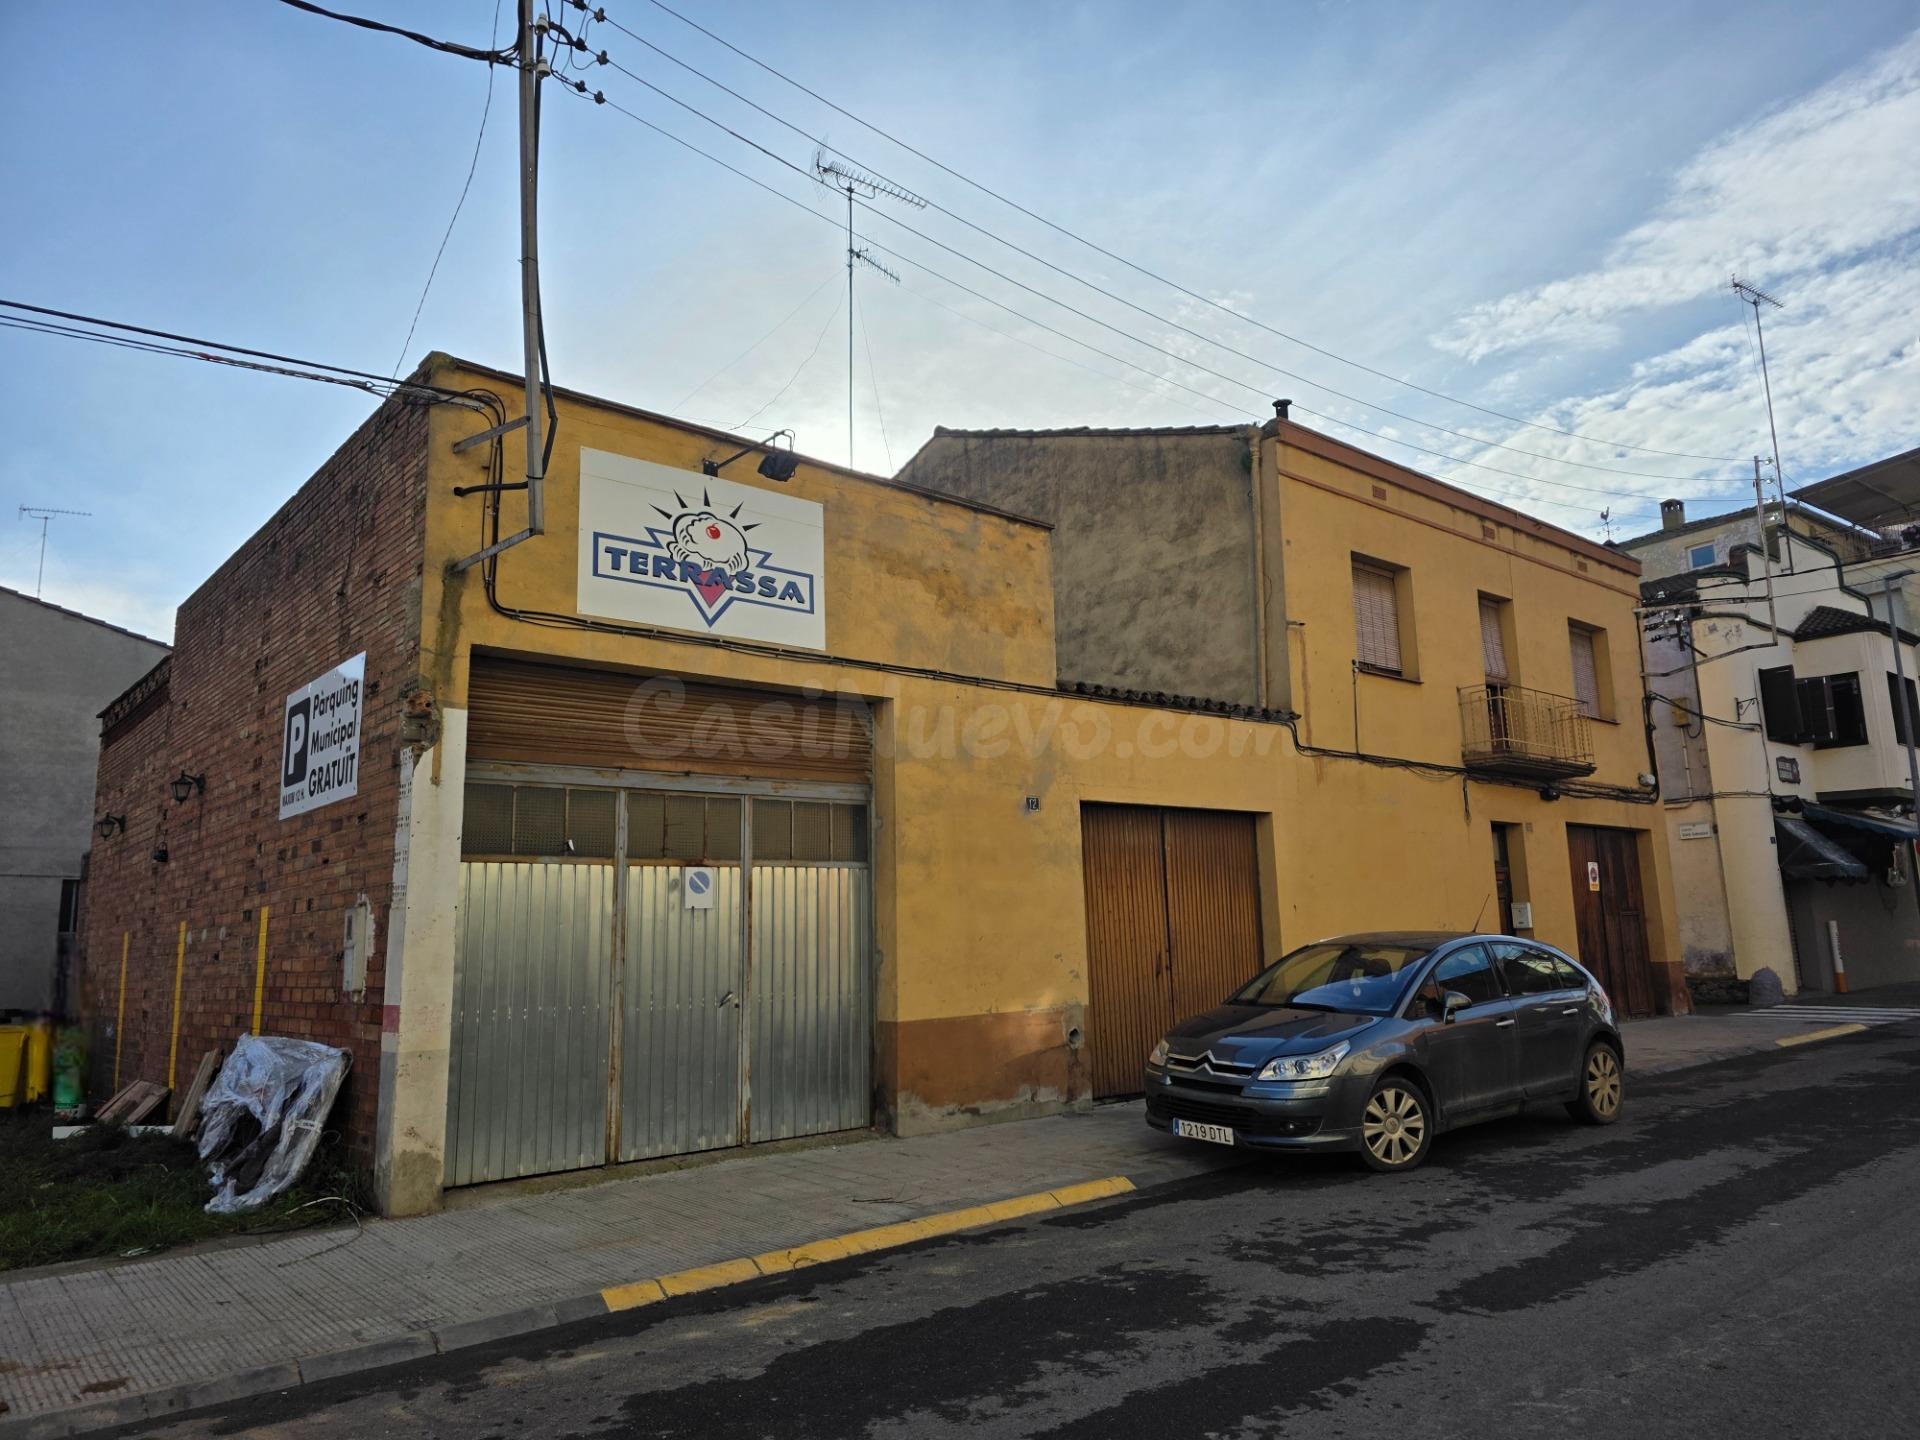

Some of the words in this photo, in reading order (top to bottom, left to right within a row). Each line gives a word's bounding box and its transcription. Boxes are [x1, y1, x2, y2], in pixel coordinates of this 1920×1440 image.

[604, 545, 806, 604] TERRASSA
[312, 677, 359, 719] Pàrquing
[287, 712, 305, 776] P
[310, 709, 357, 756] Municipal
[308, 748, 356, 797] GRATUÏT
[1181, 1122, 1207, 1138] 1219
[1209, 1126, 1231, 1143] DTL
